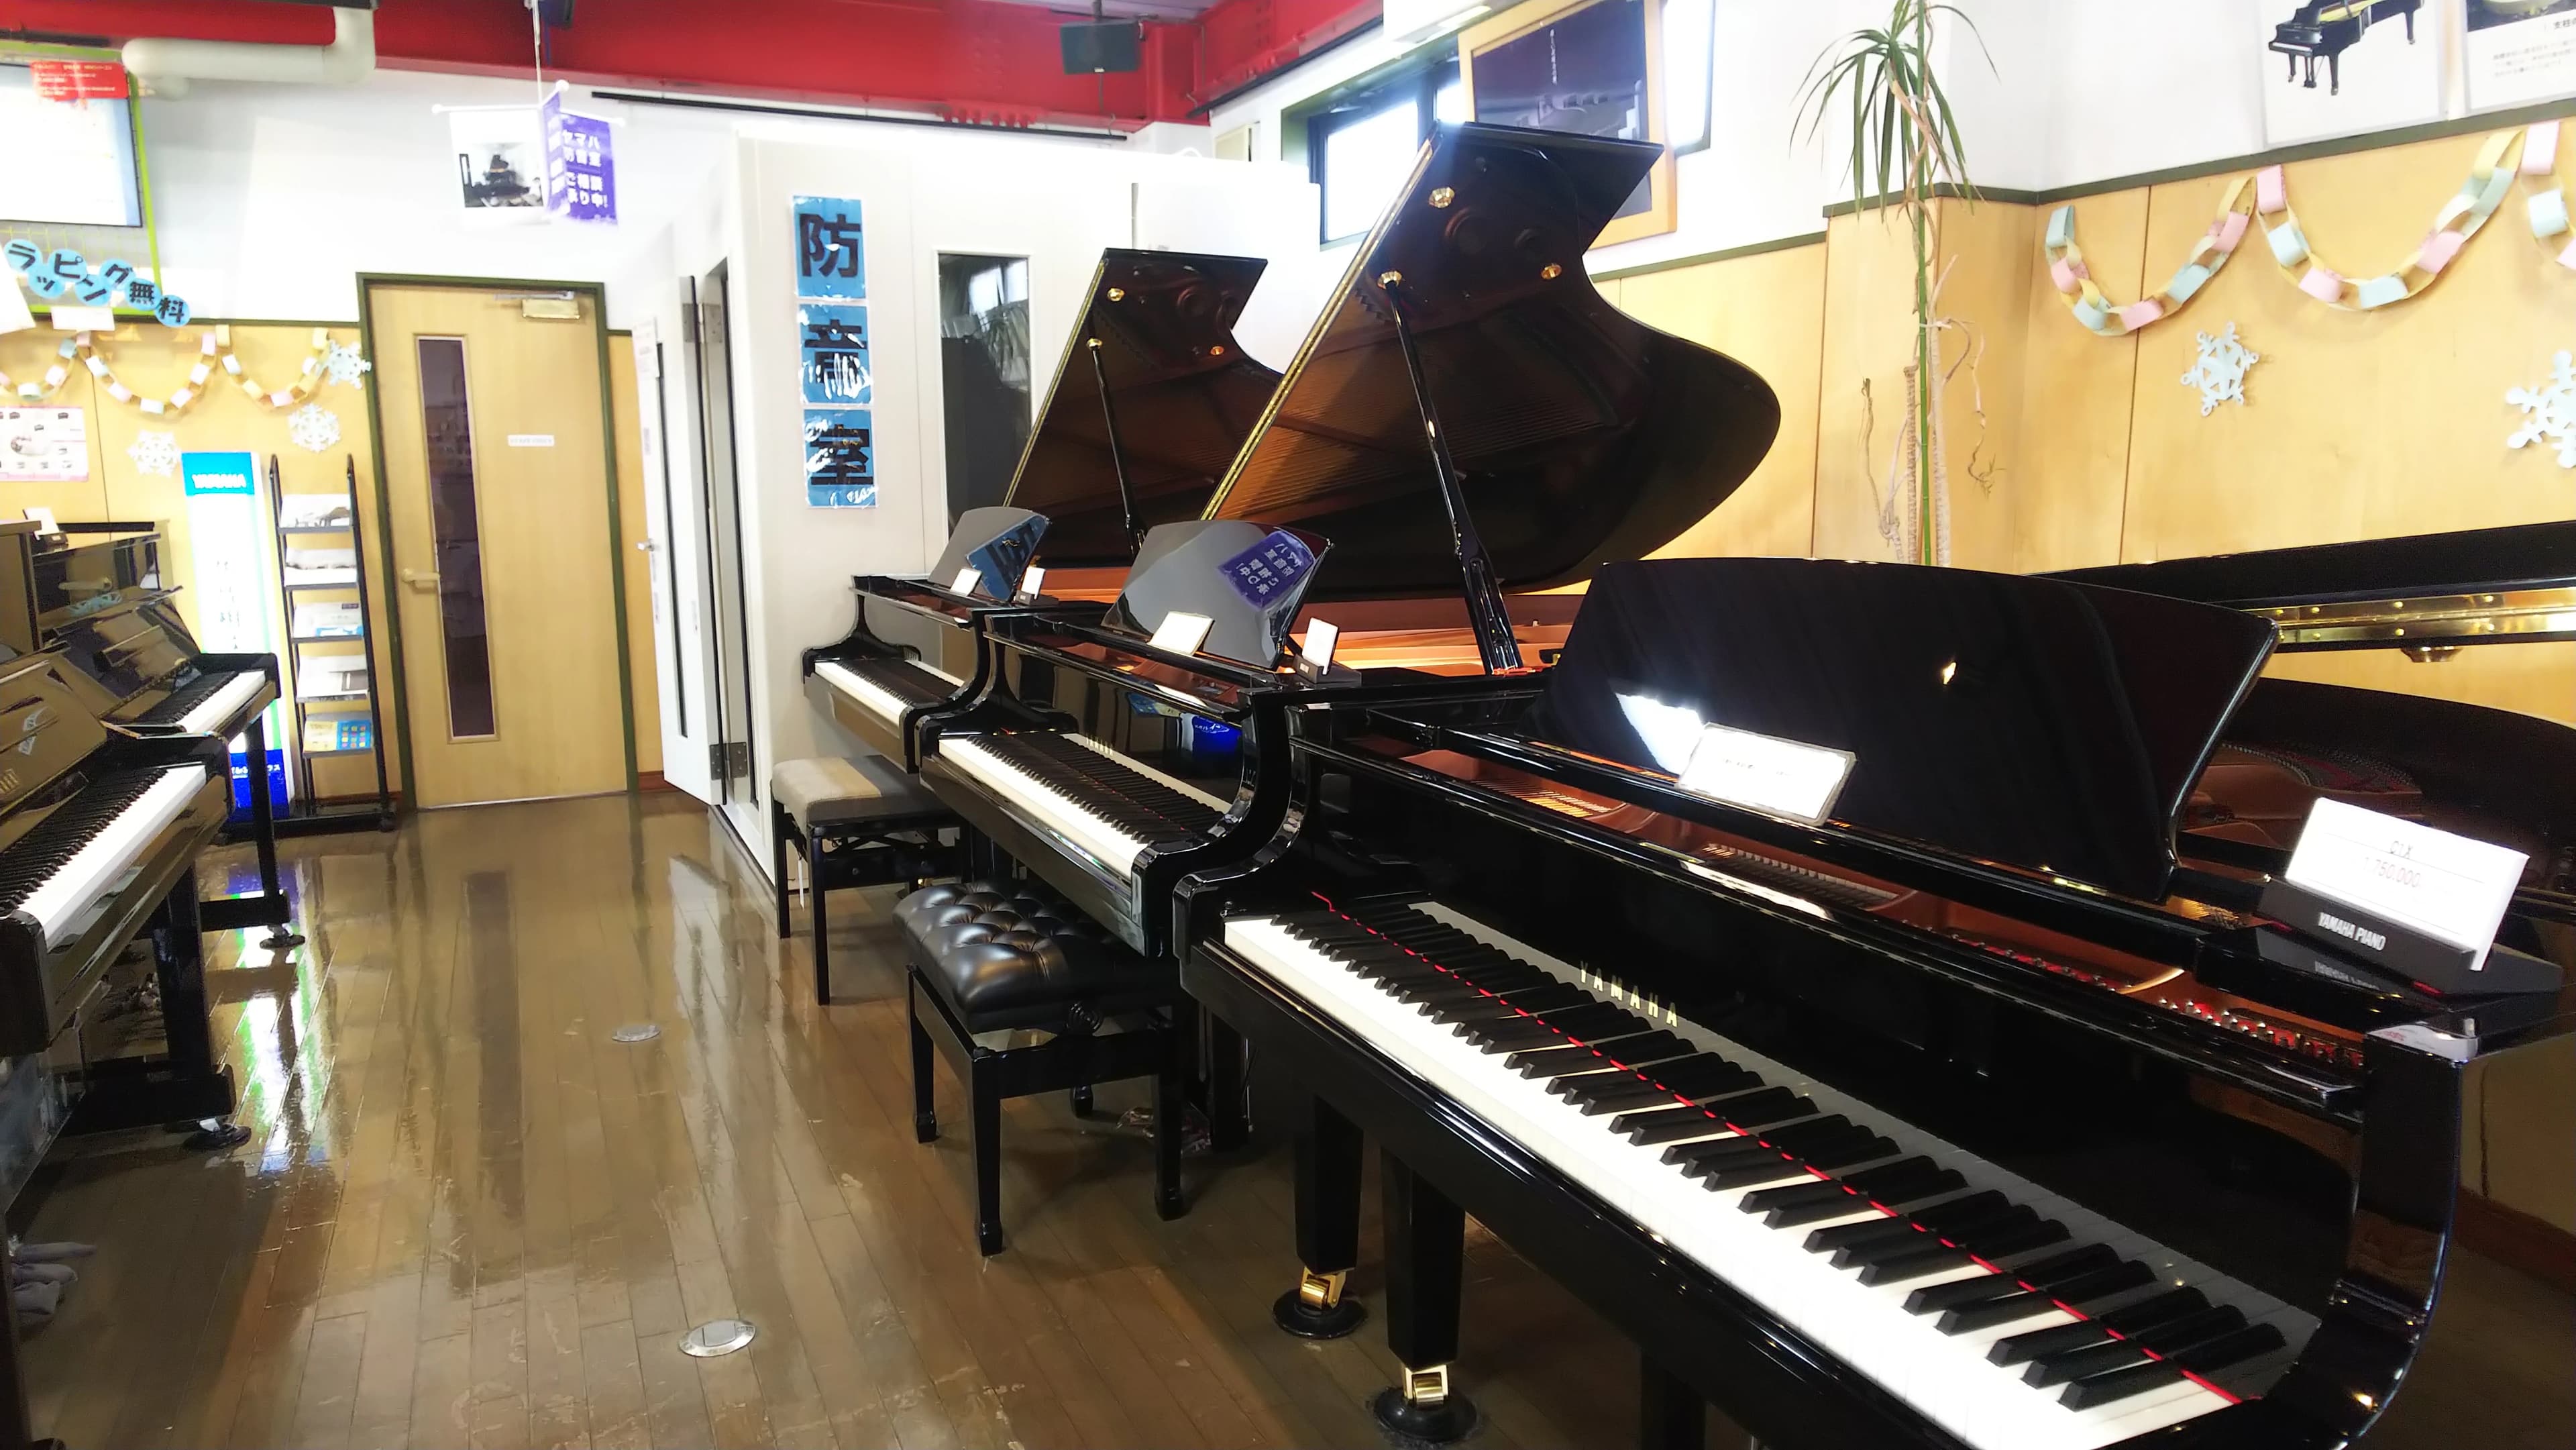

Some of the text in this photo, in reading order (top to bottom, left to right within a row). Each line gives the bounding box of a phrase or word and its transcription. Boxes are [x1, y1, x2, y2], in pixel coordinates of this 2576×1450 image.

[799, 213, 873, 486] 防音室
[2318, 913, 2386, 951] YAMAHA PIANO
[1580, 960, 1678, 1027] YAMAHA
